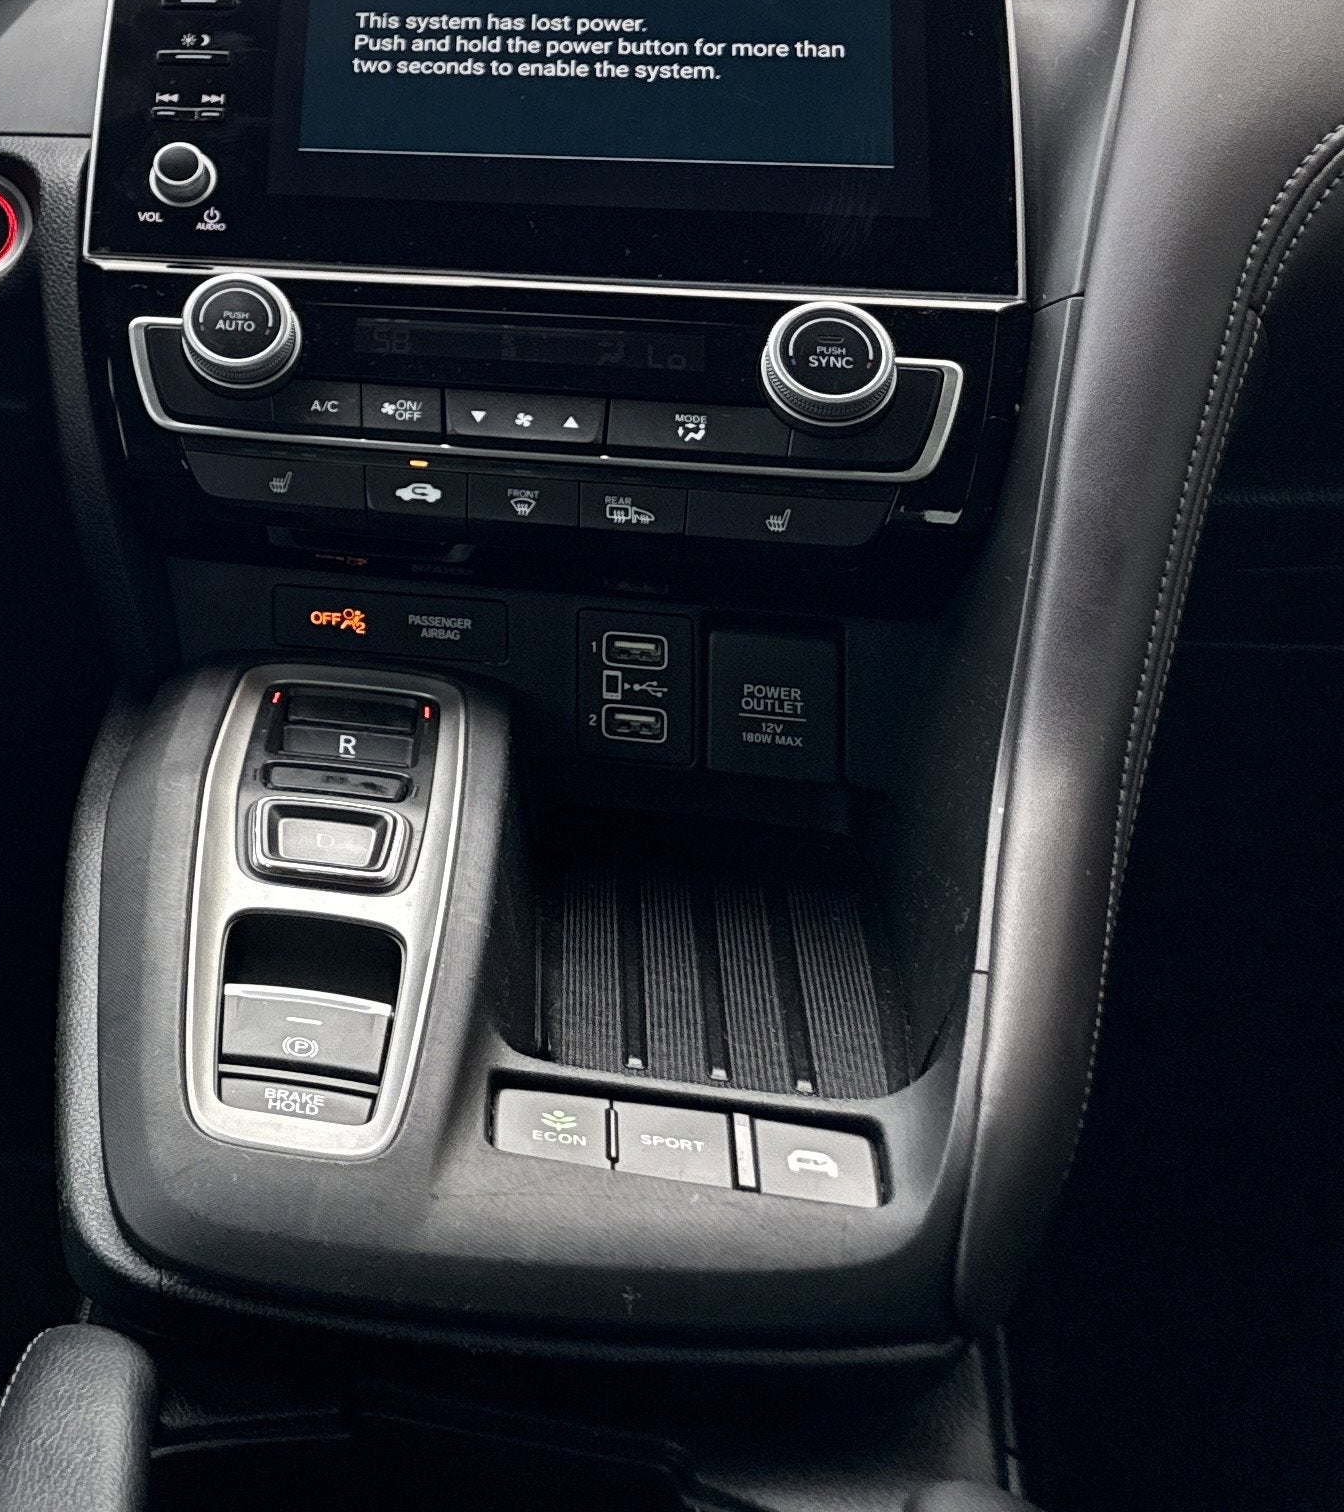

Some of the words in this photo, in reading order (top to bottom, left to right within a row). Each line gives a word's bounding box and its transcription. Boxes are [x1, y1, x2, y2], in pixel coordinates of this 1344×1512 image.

[355, 12, 400, 30] This
[405, 14, 482, 34] system
[486, 12, 526, 31] has
[531, 14, 572, 32] lost
[576, 17, 648, 36] power.
[354, 34, 406, 52] Push
[411, 36, 450, 52] and
[456, 35, 501, 53] hold
[506, 36, 541, 54] the
[546, 39, 613, 57] power
[618, 37, 688, 56] button
[694, 38, 726, 56] for
[731, 42, 790, 58] more
[794, 40, 845, 58] than
[352, 58, 391, 74] two
[396, 58, 485, 76] seconds
[490, 60, 514, 76] to
[517, 60, 590, 78] enable
[594, 60, 630, 78] the
[634, 62, 721, 82] system.
[138, 212, 164, 222] VOL
[195, 222, 227, 232] AUDIO
[223, 310, 250, 319] PUSH
[215, 319, 256, 332] AUTO
[816, 346, 846, 356] PUSH
[808, 356, 854, 369] SYNC
[310, 400, 340, 412] A/C
[396, 400, 423, 411] ON/
[394, 410, 423, 422] OFF
[674, 414, 708, 424] MODE
[507, 488, 540, 499] FRONT
[604, 495, 632, 505] REAR
[310, 610, 342, 626] OFF
[408, 614, 472, 630] PASSENGER
[420, 627, 461, 640] AIRBAG
[591, 641, 597, 653] 1
[743, 684, 801, 700] POWER
[741, 697, 804, 714] OUTLET
[588, 714, 598, 726] 2
[761, 722, 784, 734] 12V
[338, 734, 357, 755] R
[742, 732, 772, 744] 180W
[774, 735, 803, 748] MAX
[264, 1088, 326, 1107] BRAKE
[268, 1098, 319, 1116] HOLD
[532, 1130, 587, 1147] ECON
[640, 1134, 705, 1153] SPORT
